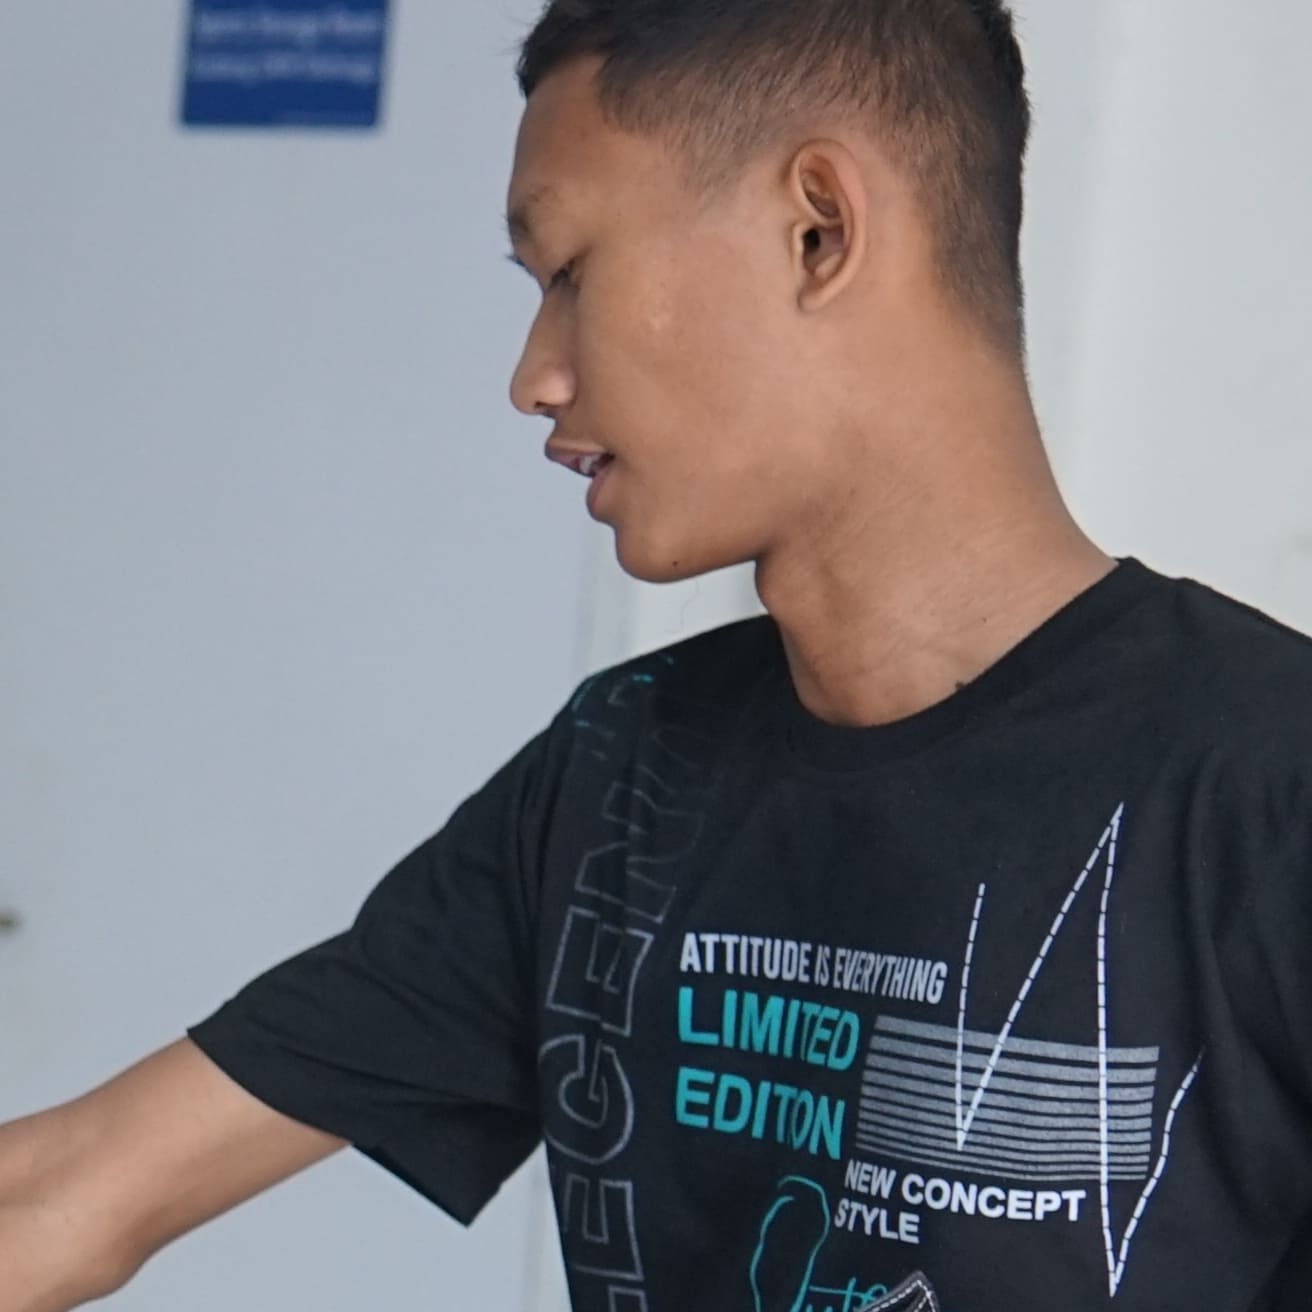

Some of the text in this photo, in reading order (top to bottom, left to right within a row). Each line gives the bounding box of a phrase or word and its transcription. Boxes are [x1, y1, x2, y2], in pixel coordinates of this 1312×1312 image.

[680, 932, 947, 1004] ATTITUDE IS EVERYTHING
[678, 986, 860, 1071] LIMITED
[677, 1066, 845, 1160] EDITON
[834, 1198, 920, 1244] STYLE
[844, 1159, 1087, 1222] NEW CONCEPT
